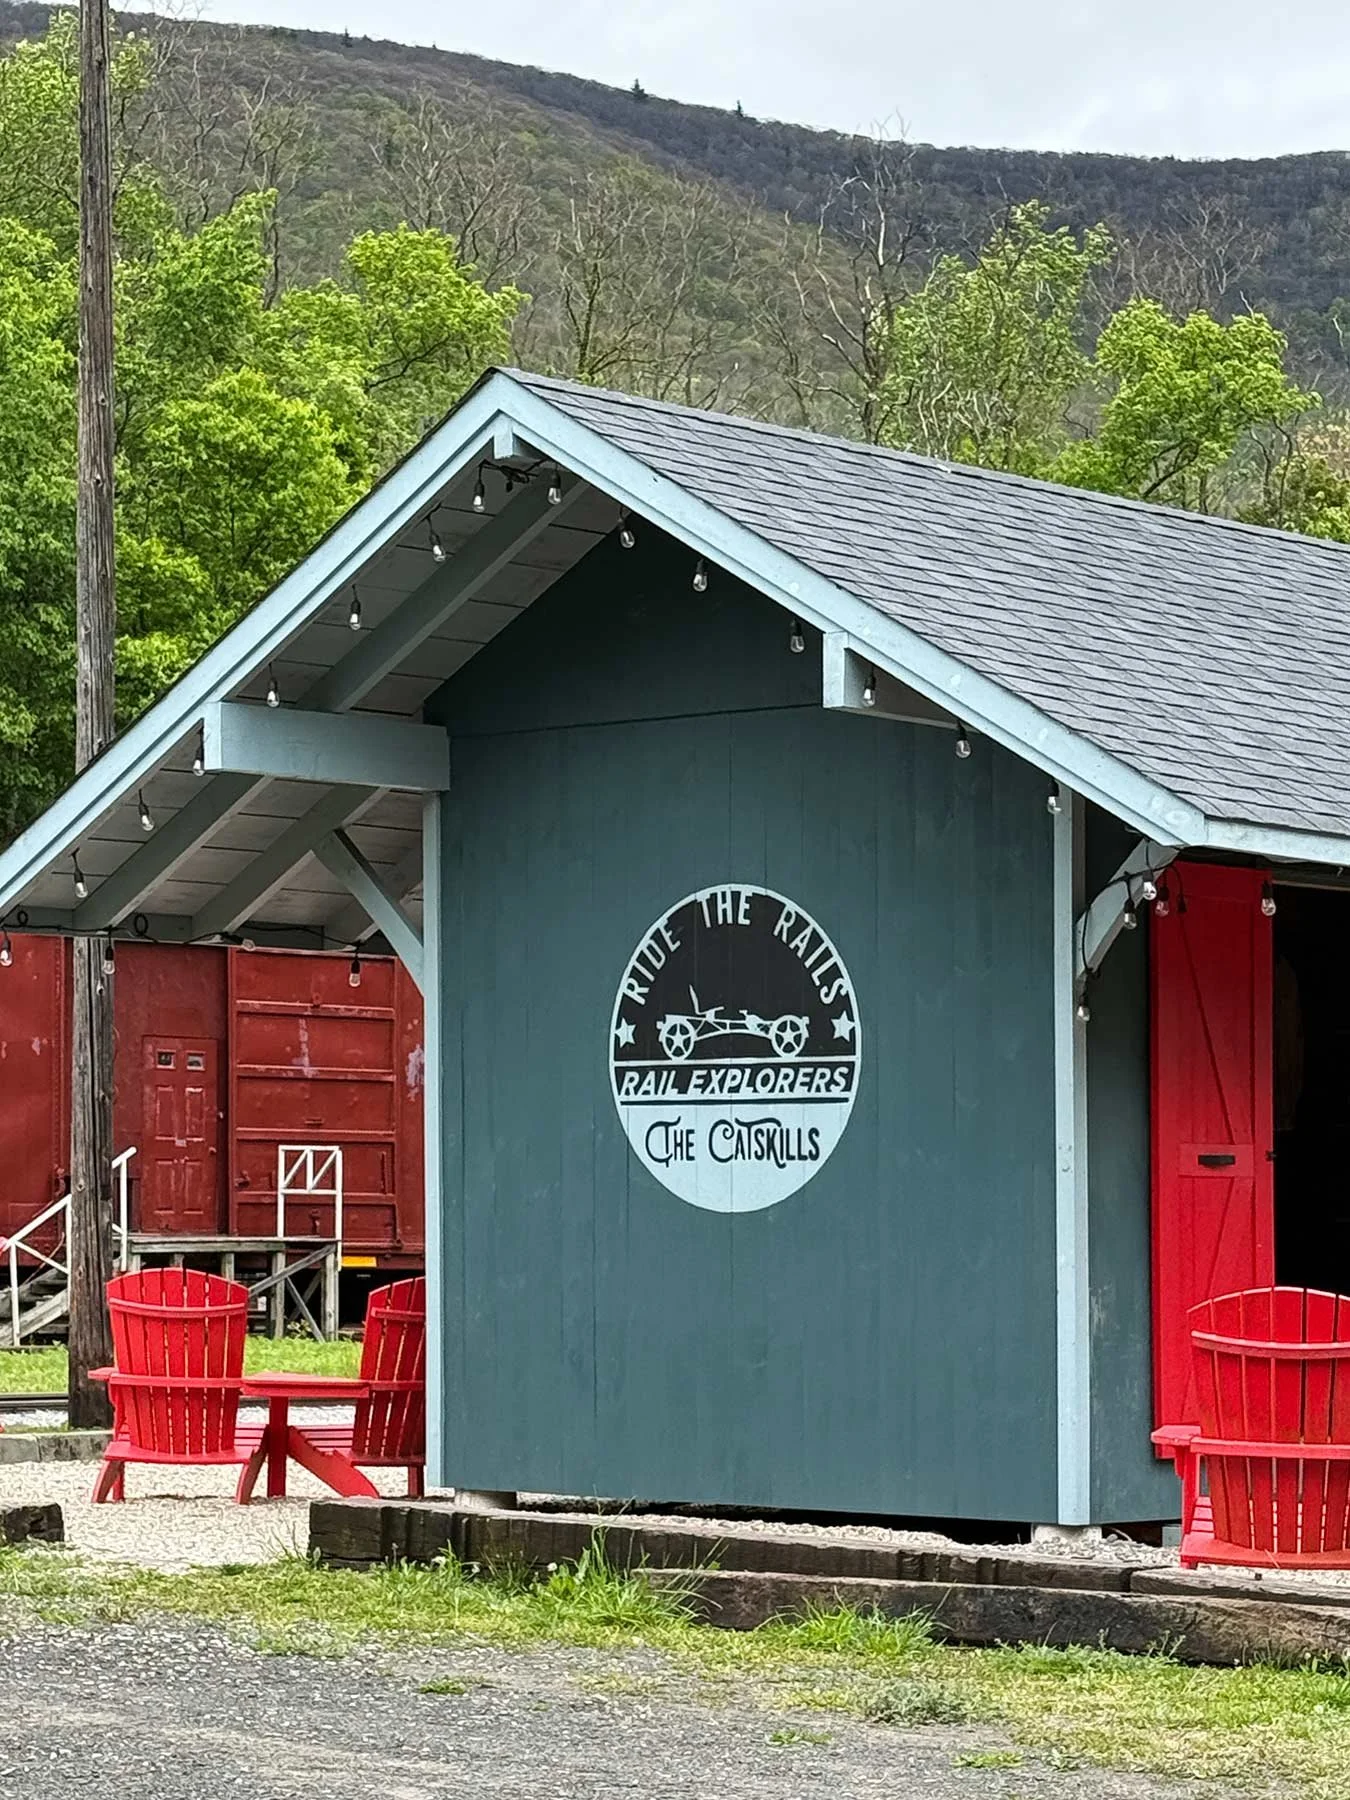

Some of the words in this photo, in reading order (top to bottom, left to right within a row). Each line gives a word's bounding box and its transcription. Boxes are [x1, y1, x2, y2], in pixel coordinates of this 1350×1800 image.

[623, 918, 681, 1005] RIDE
[697, 890, 752, 928] THE
[773, 903, 848, 1005] RAILS
[620, 1071, 679, 1096] RAIL
[687, 1067, 849, 1095] EXPLORERS
